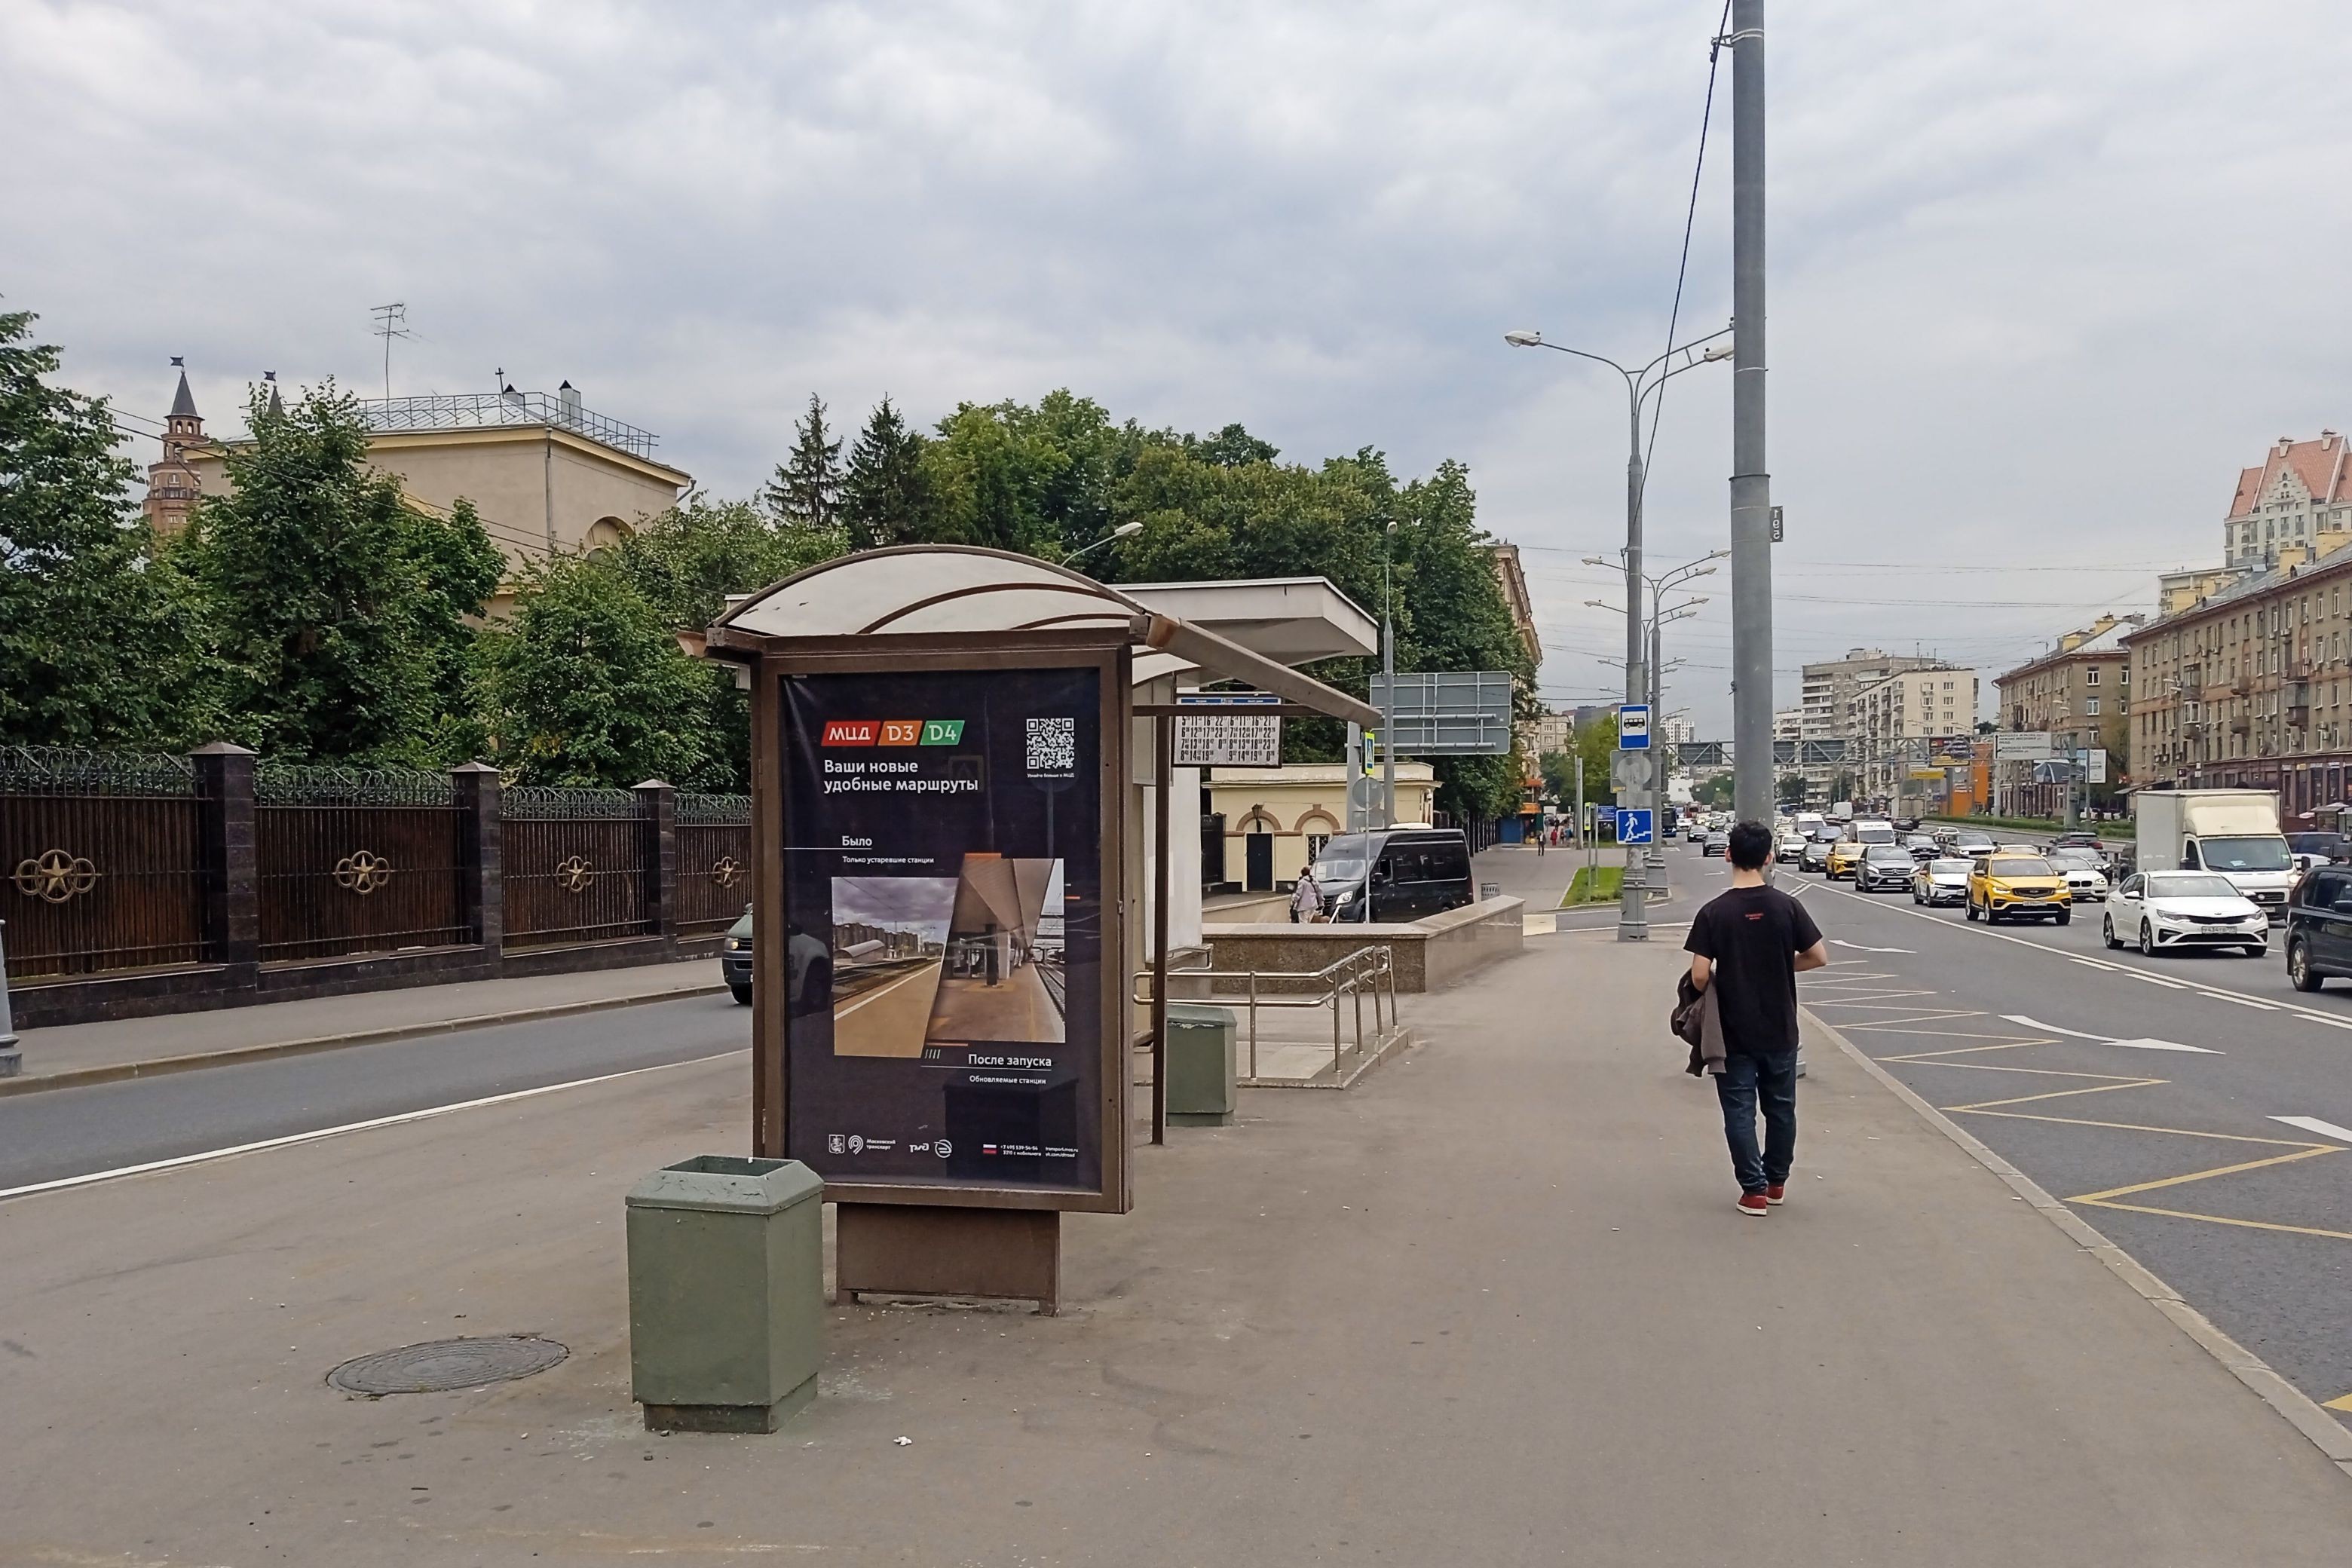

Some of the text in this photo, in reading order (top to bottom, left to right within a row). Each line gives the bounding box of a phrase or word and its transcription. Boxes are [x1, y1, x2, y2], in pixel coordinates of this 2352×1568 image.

[1182, 716, 1186, 726] 5
[1192, 716, 1197, 726] 11
[1204, 716, 1210, 726] 16
[1215, 716, 1223, 726] 22
[1240, 716, 1245, 726] 11
[1252, 716, 1259, 726] 16
[1264, 716, 1270, 726] 21
[828, 727, 871, 741] МЦД
[887, 725, 914, 741] D3
[929, 724, 957, 741] D4
[1182, 727, 1185, 737] 6
[1191, 727, 1197, 737] 12
[1203, 727, 1210, 737] 17
[1215, 727, 1222, 737] 23
[1230, 727, 1233, 737] 7
[1239, 727, 1245, 737] 12
[1251, 727, 1258, 737] 17
[1263, 727, 1271, 737] 22
[1181, 739, 1184, 749] 7
[1190, 739, 1197, 749] 13
[1203, 739, 1209, 749] 18
[1218, 739, 1222, 749] 0
[1230, 739, 1233, 749] 8
[1239, 739, 1245, 749] 13
[1251, 739, 1257, 749] 18
[1263, 739, 1270, 749] 23
[1181, 750, 1184, 761] 8
[1190, 750, 1196, 761] 14
[1202, 750, 1209, 761] 19
[1229, 751, 1233, 761] 9
[1239, 751, 1245, 761] 14
[1251, 751, 1257, 761] 19
[1266, 751, 1270, 761] 0
[824, 759, 918, 773] Ваши новые
[824, 776, 978, 794] удобные маршруты
[842, 835, 873, 846] Было
[968, 1053, 1052, 1068] После запуска
[969, 1075, 1018, 1083] Обновляемые
